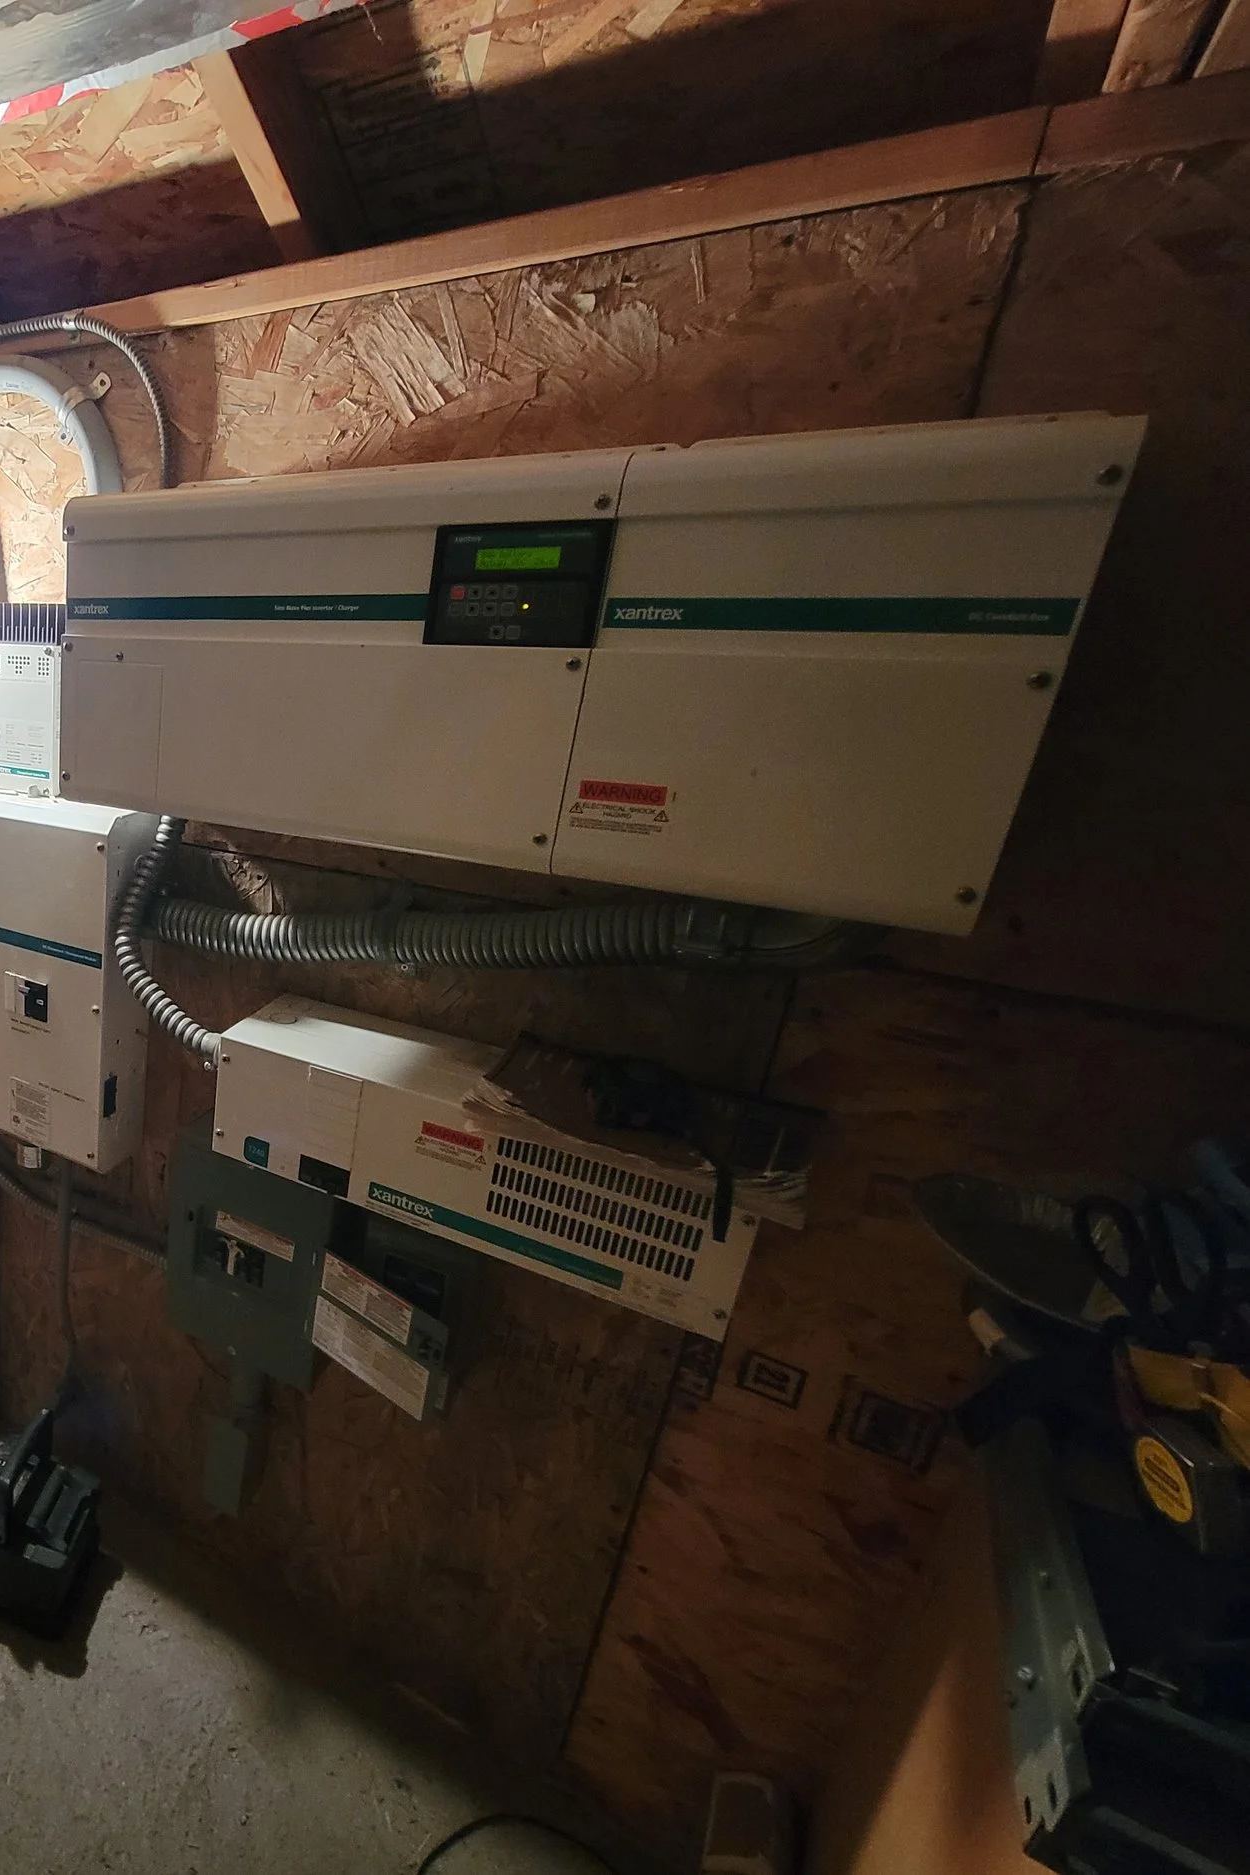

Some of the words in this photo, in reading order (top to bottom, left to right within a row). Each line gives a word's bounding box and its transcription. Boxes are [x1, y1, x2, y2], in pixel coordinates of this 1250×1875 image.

[73, 603, 109, 615] xantrex
[613, 606, 684, 621] xantrex
[583, 783, 663, 803] WARNING
[371, 1186, 435, 1219] xantrex
